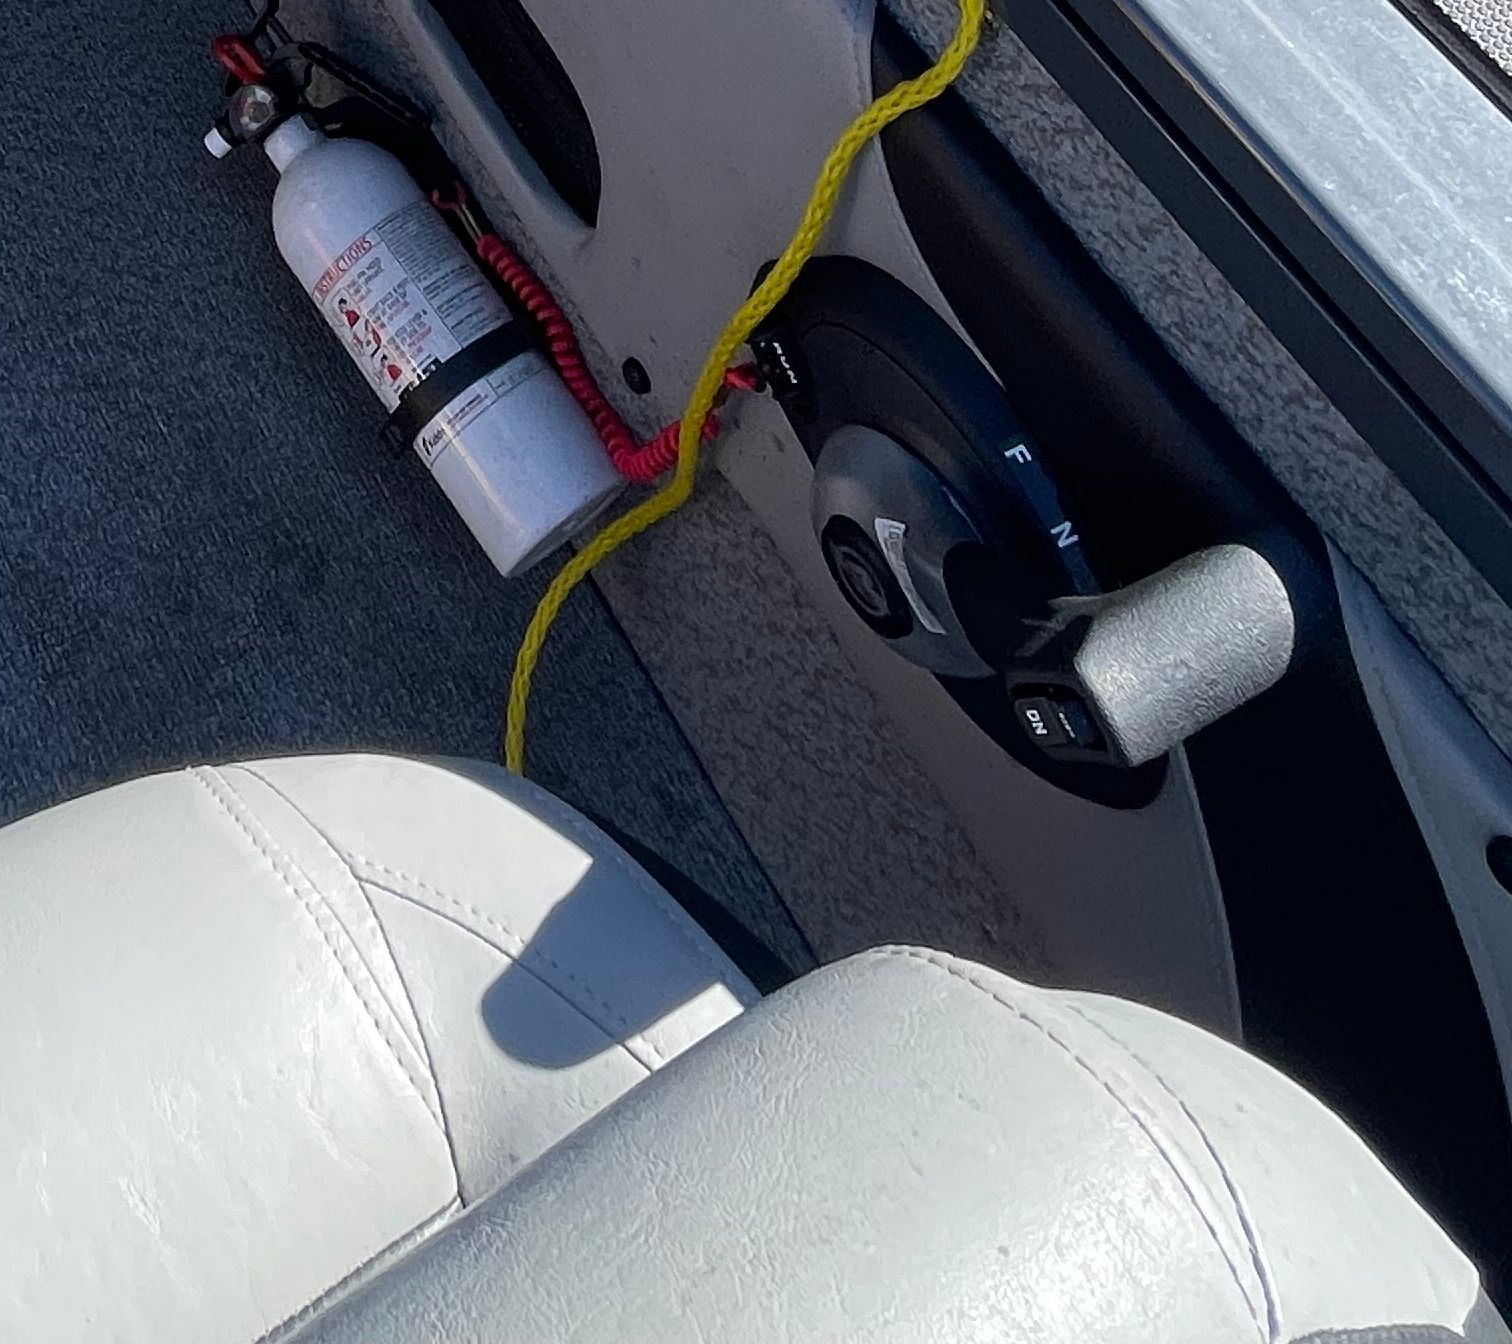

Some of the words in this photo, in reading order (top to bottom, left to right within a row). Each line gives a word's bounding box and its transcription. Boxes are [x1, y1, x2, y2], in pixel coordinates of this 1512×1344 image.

[315, 236, 373, 302] NSTRUCTIONS
[1004, 444, 1032, 464] F
[1050, 521, 1079, 547] N
